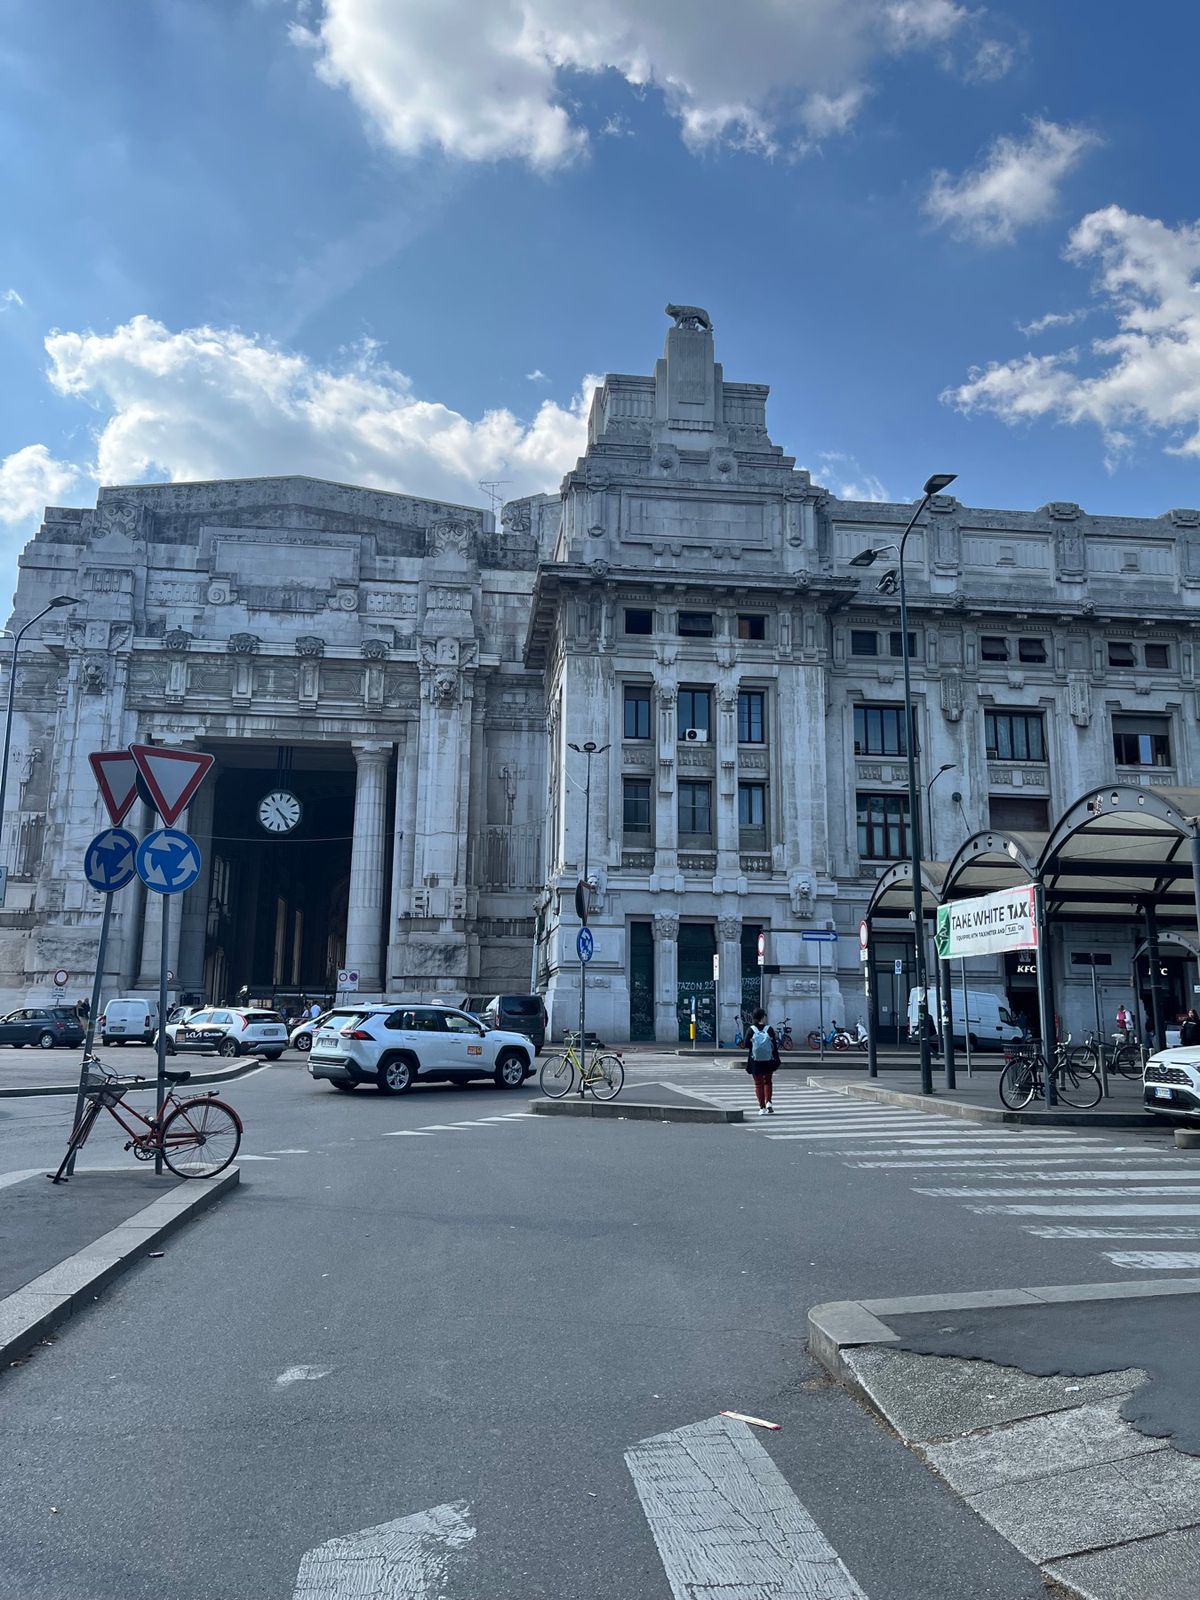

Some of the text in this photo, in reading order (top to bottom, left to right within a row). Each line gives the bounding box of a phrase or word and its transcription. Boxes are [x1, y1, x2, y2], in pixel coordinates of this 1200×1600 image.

[952, 913, 972, 930] TAKE
[973, 906, 1005, 926] WHITE
[1017, 965, 1037, 973] KFC
